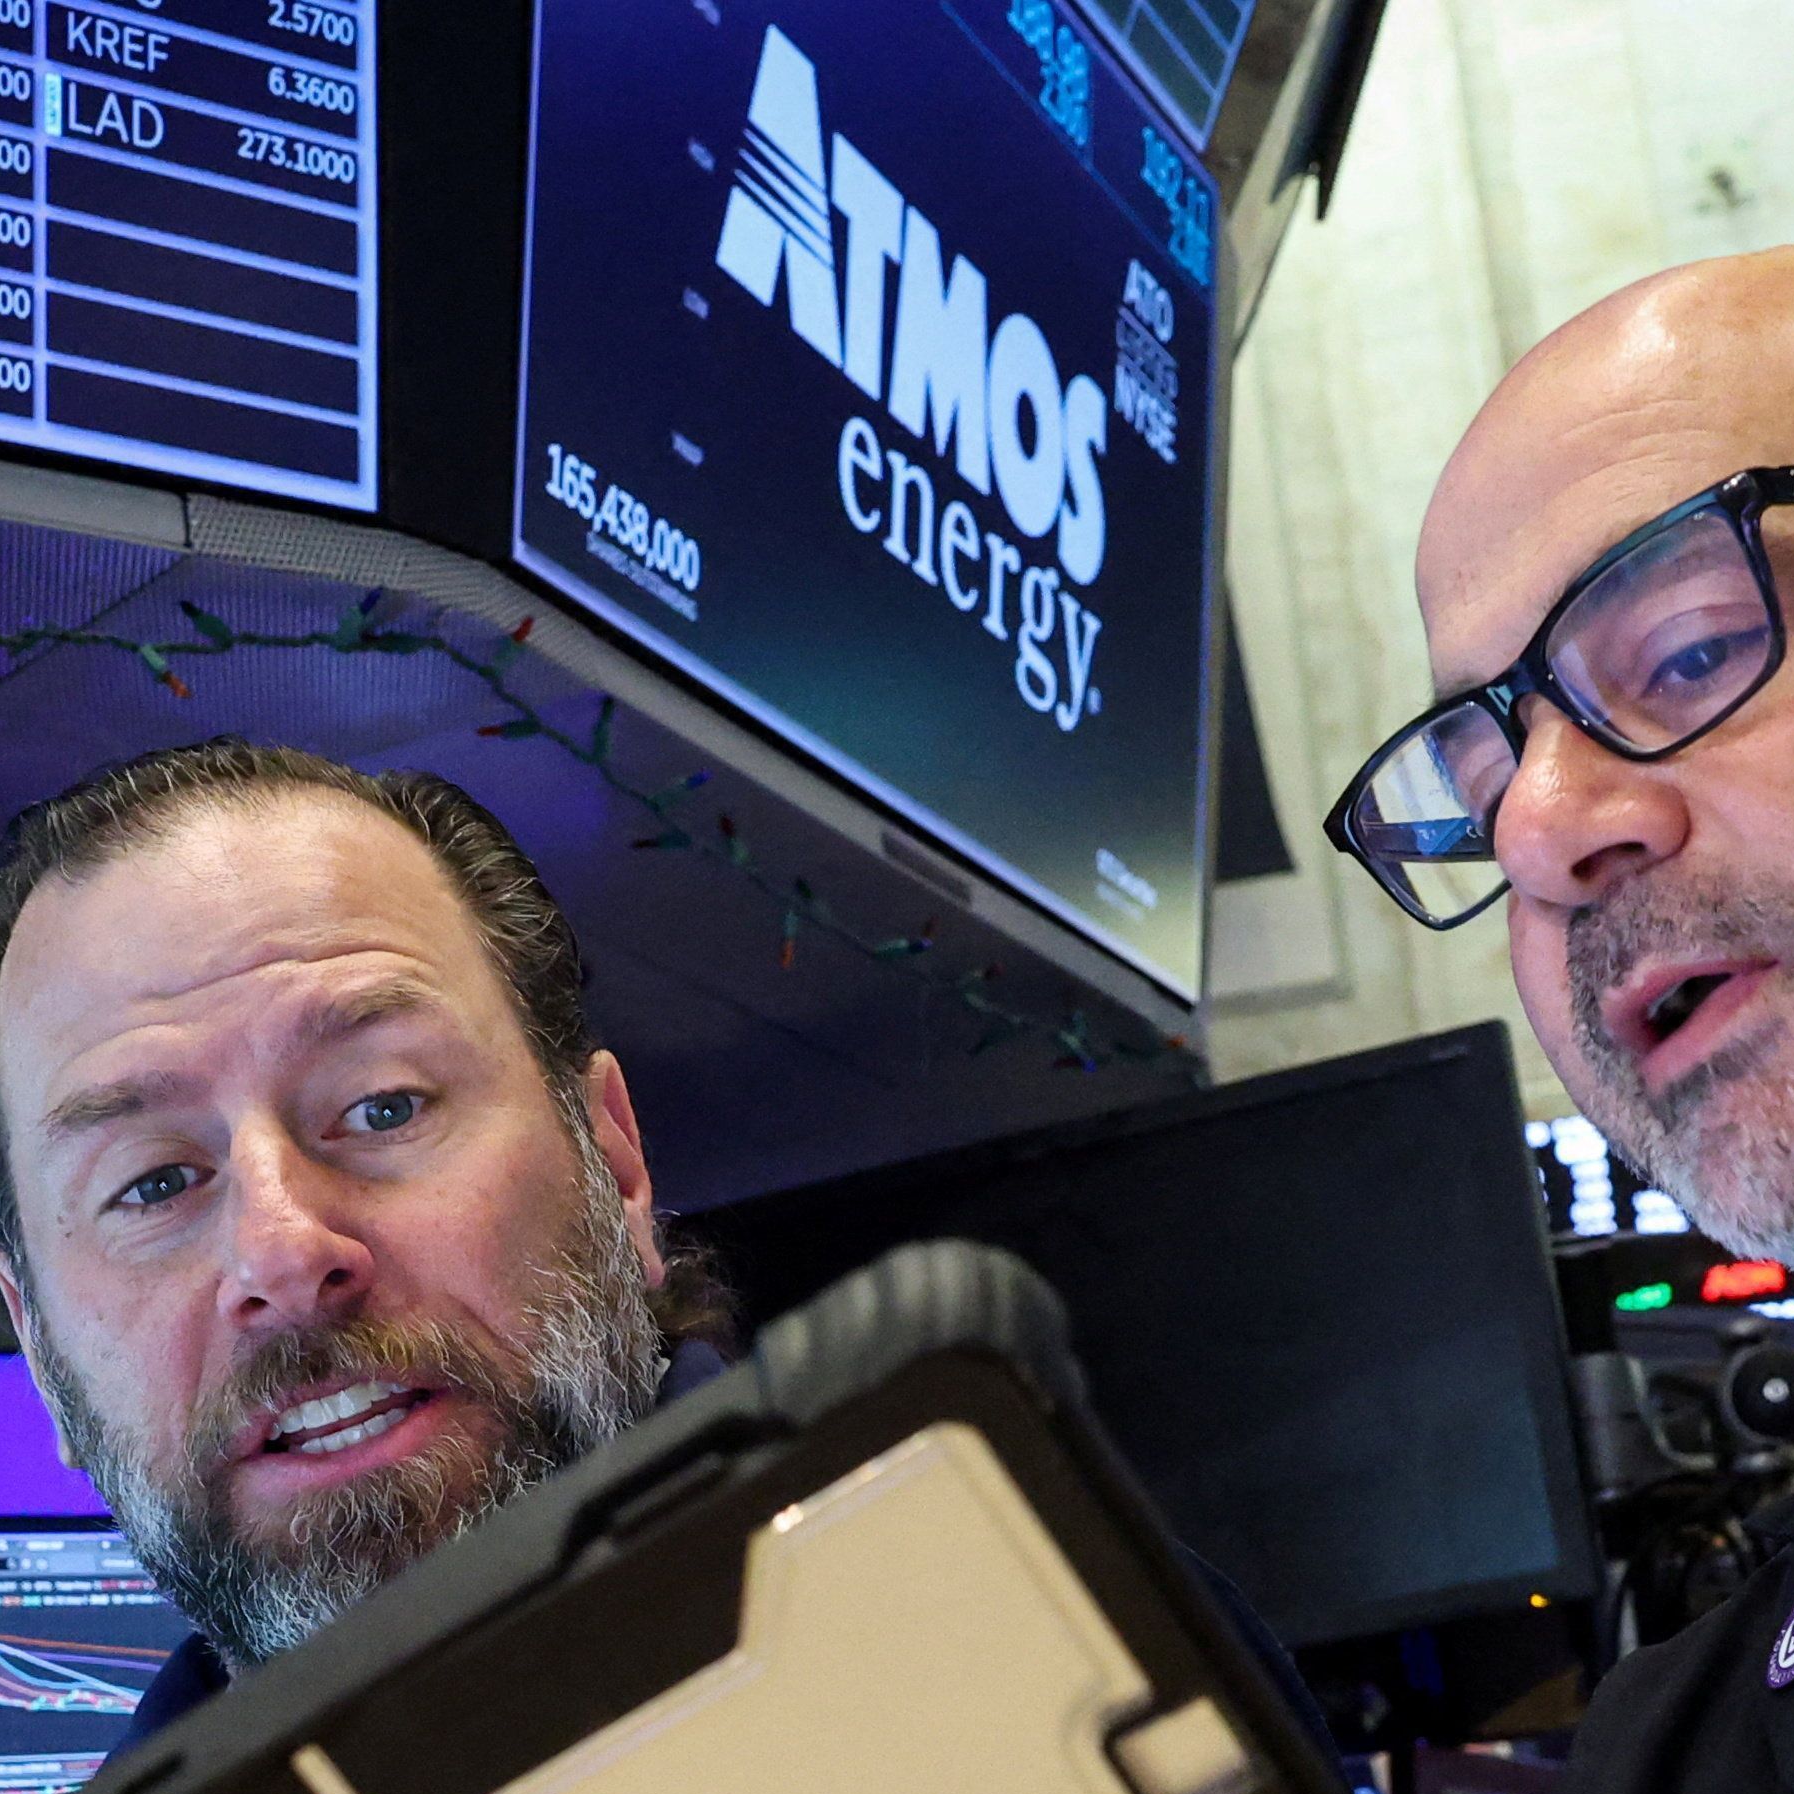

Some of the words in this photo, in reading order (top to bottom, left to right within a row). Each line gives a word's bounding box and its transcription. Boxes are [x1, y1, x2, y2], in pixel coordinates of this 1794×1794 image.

[66, 11, 170, 73] KREF
[268, 67, 355, 115] 6.3600
[268, 0, 354, 46] 2.5700
[68, 82, 164, 148] LAD
[237, 128, 355, 183] 273.1000
[716, 24, 1106, 584] ATMOS
[838, 416, 1102, 731] energy
